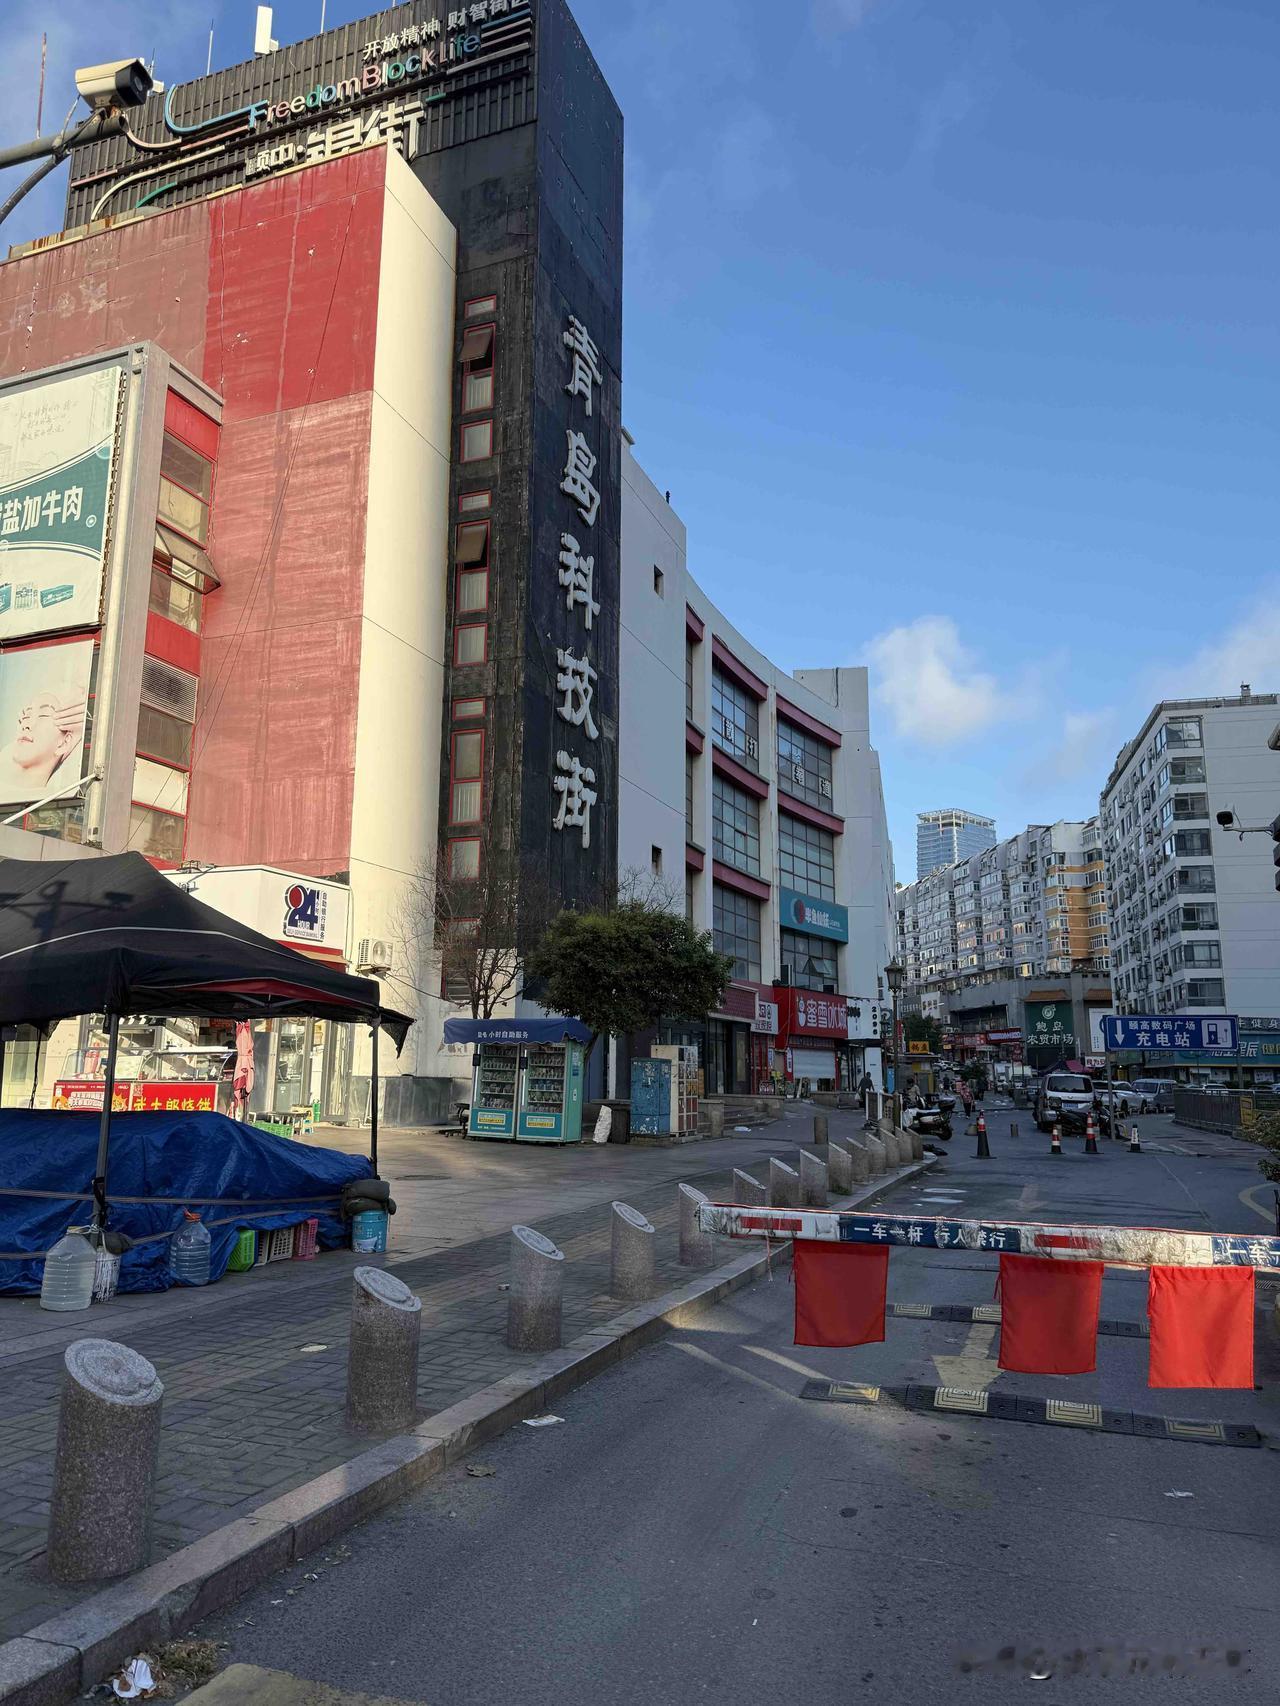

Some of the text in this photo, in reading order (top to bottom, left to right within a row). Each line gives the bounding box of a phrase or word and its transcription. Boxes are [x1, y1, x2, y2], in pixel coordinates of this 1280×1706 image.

[362, 17, 441, 60] 开放精神
[0, 485, 84, 536] 盐加牛肉
[806, 999, 848, 1030] 蜜雪冰城
[1128, 1020, 1196, 1031] 颐高数码广场
[1026, 1033, 1074, 1045] 农贸市场
[1136, 1031, 1190, 1047] 充电站
[854, 1222, 924, 1245] 一车一杆
